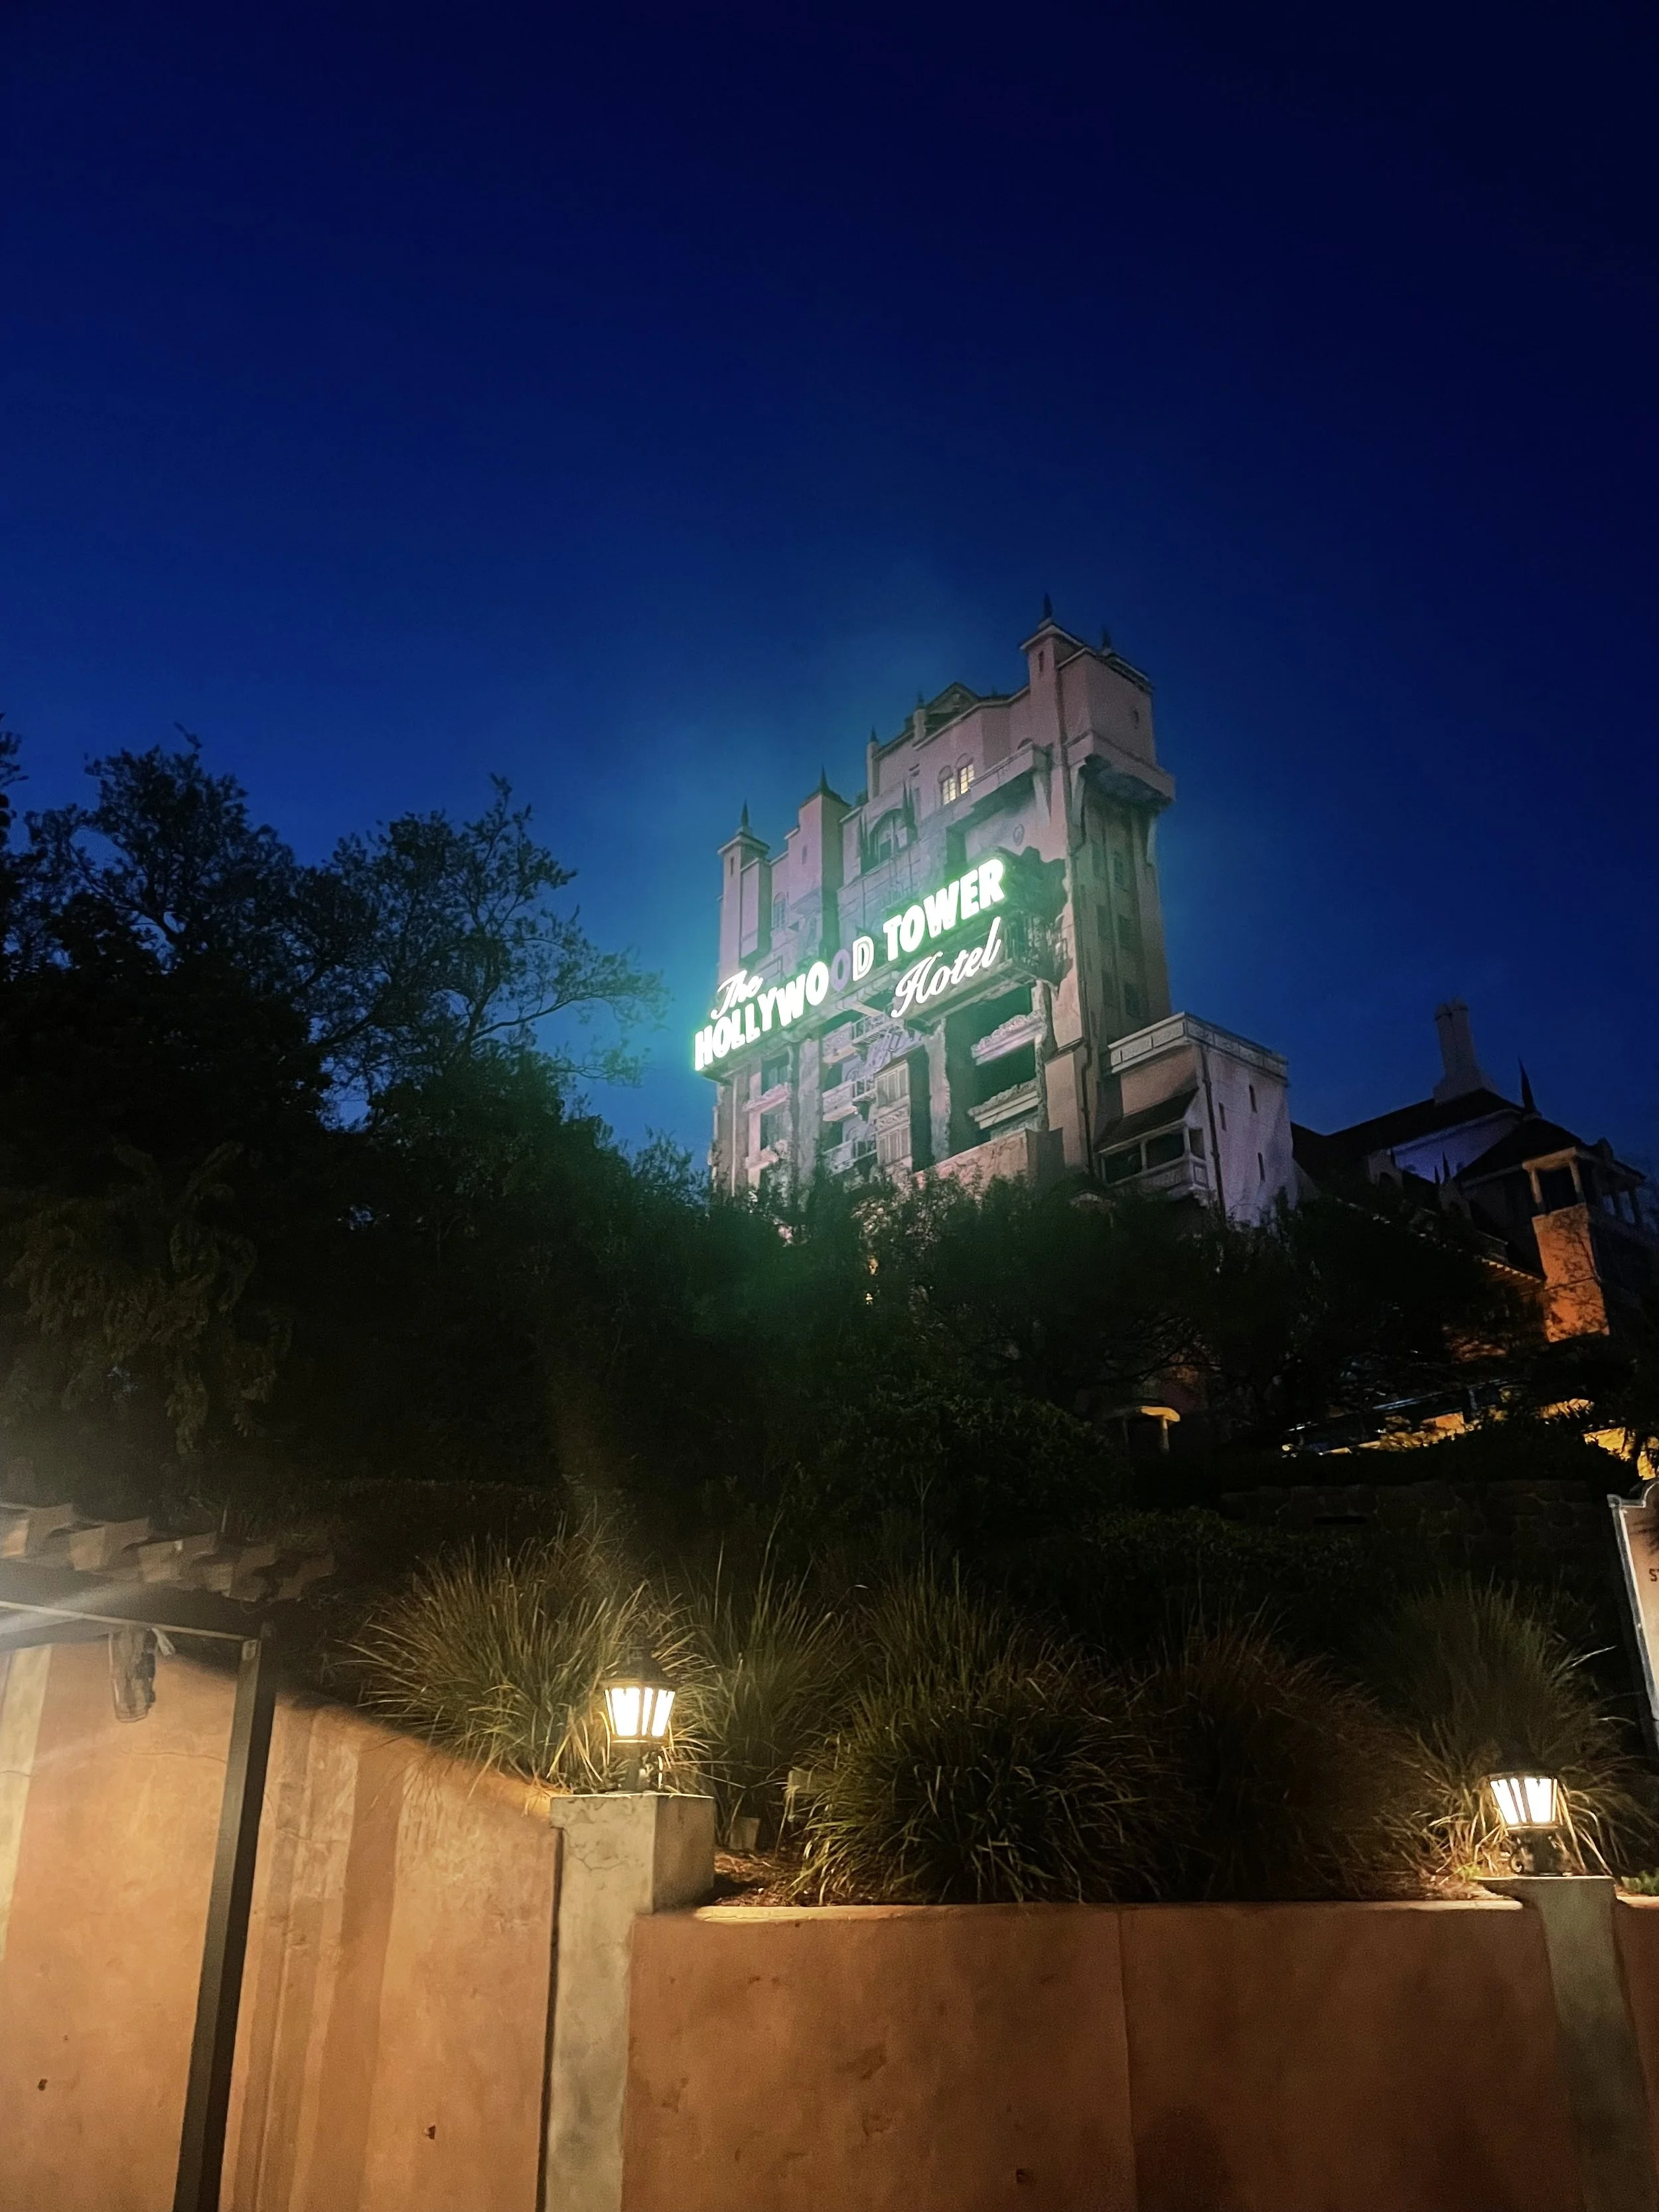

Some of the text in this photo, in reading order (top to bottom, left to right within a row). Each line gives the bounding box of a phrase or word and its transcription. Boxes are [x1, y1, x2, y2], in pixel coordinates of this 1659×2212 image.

[695, 859, 1005, 1070] HOLLYWOOD TOWER
[711, 970, 763, 1019] The
[891, 917, 1001, 1018] Hotel
